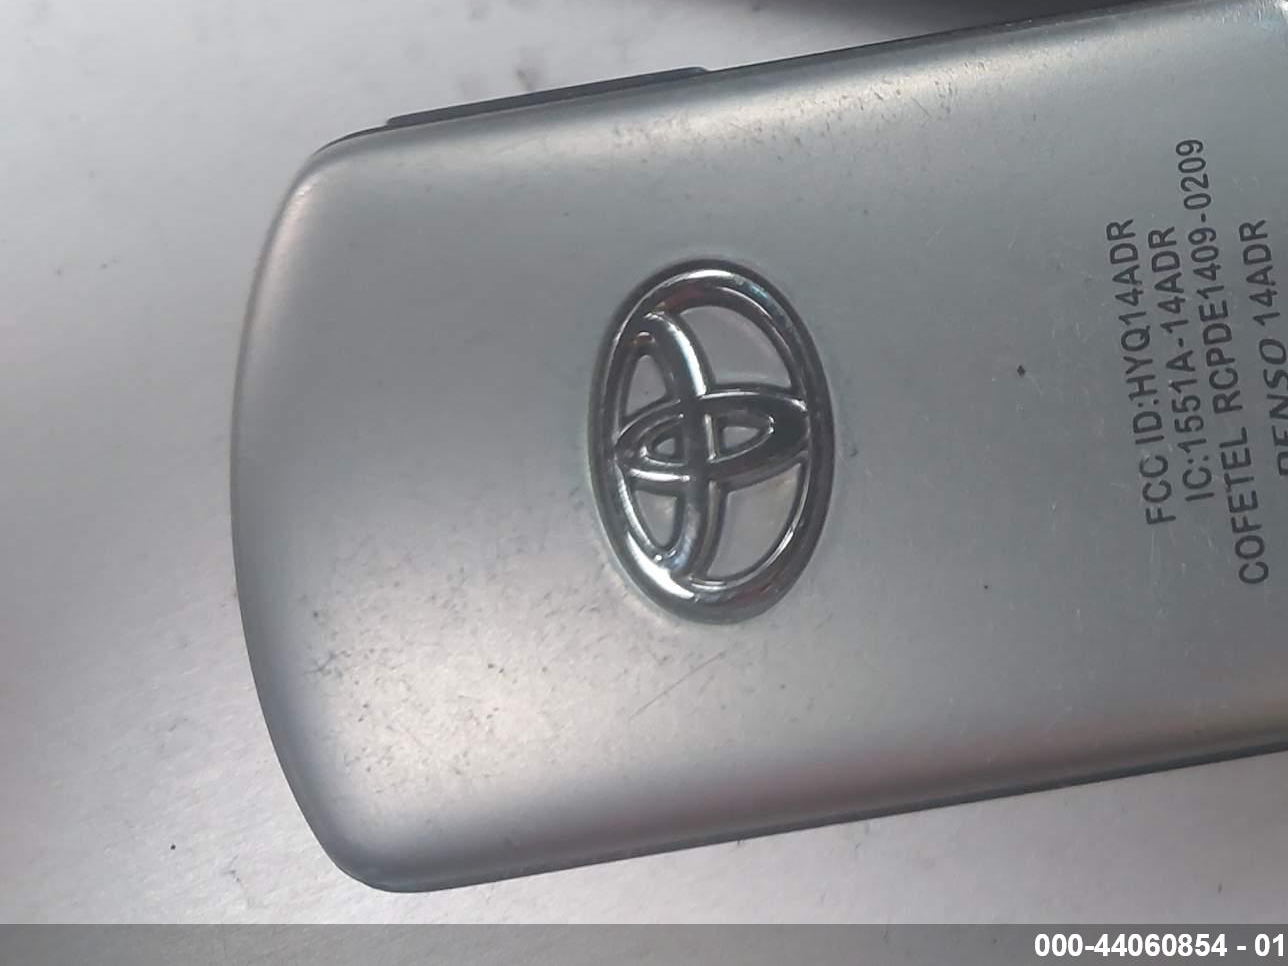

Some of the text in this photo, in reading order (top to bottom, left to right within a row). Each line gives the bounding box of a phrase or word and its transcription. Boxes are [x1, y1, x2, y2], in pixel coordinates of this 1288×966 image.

[1106, 218, 1176, 525] FCC ID:HYQ14ADR
[1148, 226, 1214, 502] IC:1551A-14ADR
[1175, 139, 1269, 584] COFETEL RCPDE1409-0209
[1238, 219, 1281, 326] 14ADR
